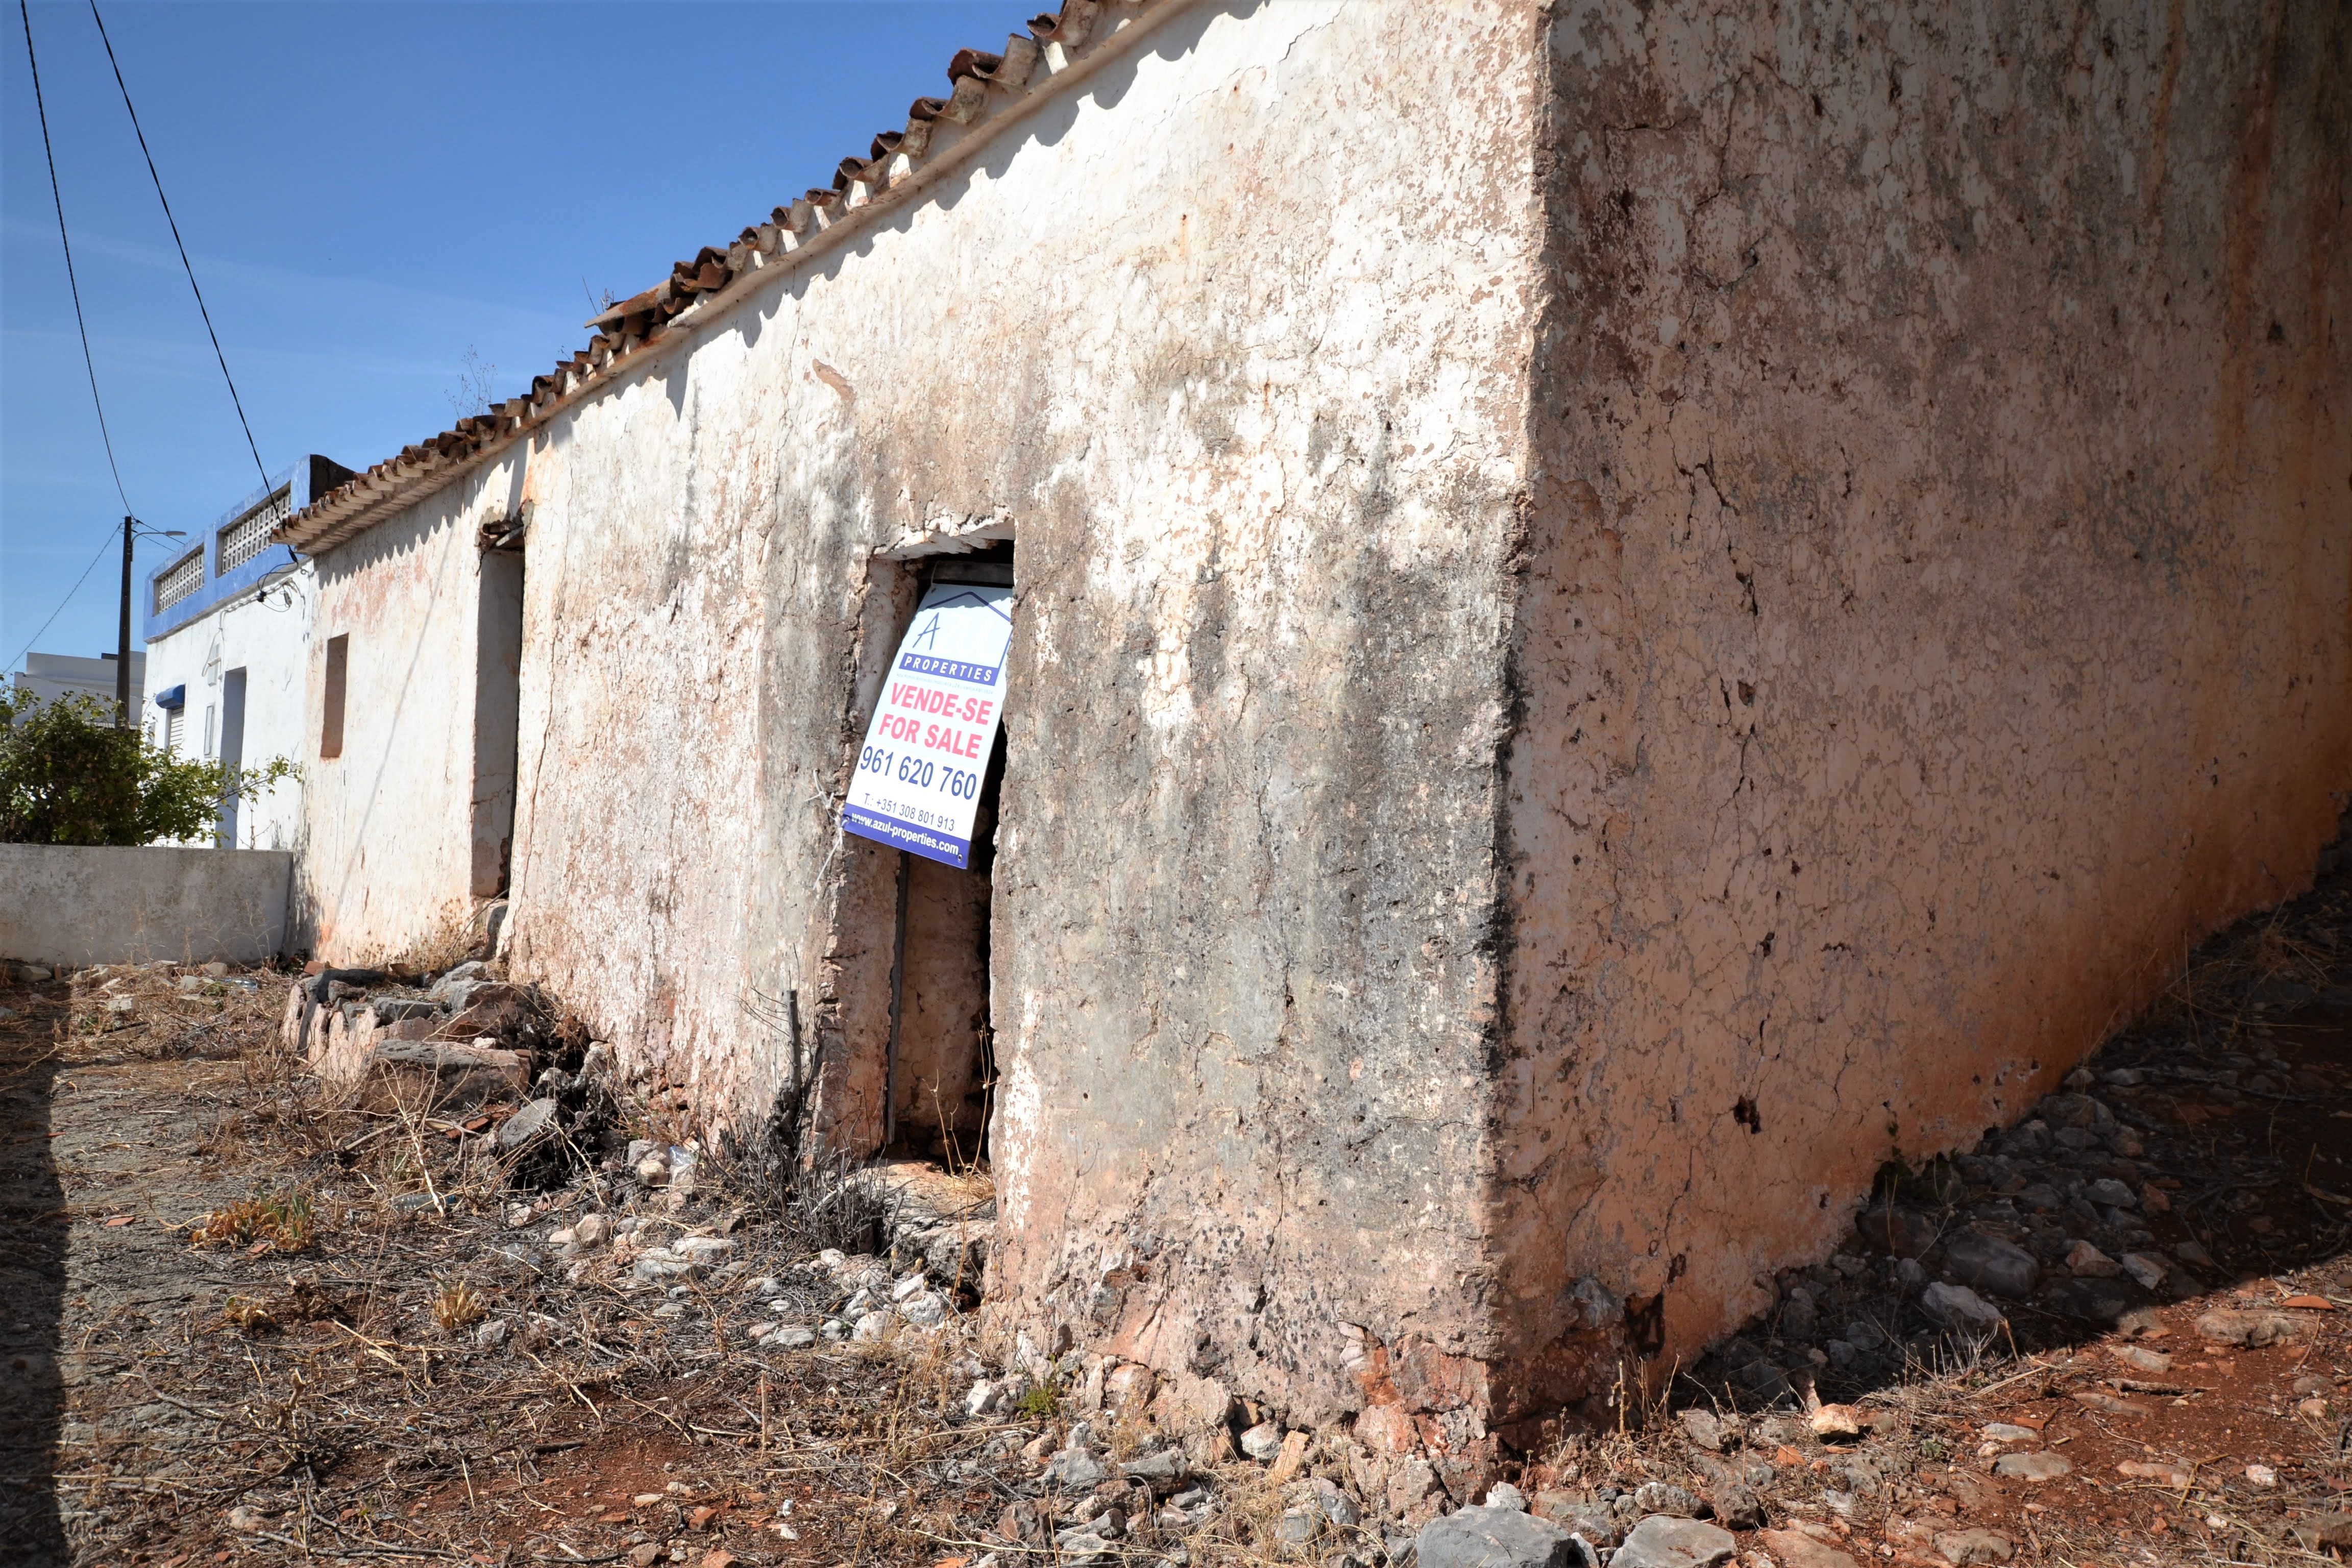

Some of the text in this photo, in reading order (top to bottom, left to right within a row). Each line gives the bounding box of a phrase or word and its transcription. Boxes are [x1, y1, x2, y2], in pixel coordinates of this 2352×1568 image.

[904, 656, 992, 681] PROPERTIES
[891, 682, 993, 725] VENDE-SE
[878, 714, 983, 759] FOR SALE
[860, 746, 976, 800] 961 620 760
[851, 813, 959, 855] www.azul-properties.com
[876, 799, 896, 814] +351
[899, 804, 916, 819] 308
[918, 810, 934, 825] 801
[937, 816, 954, 831] 913
